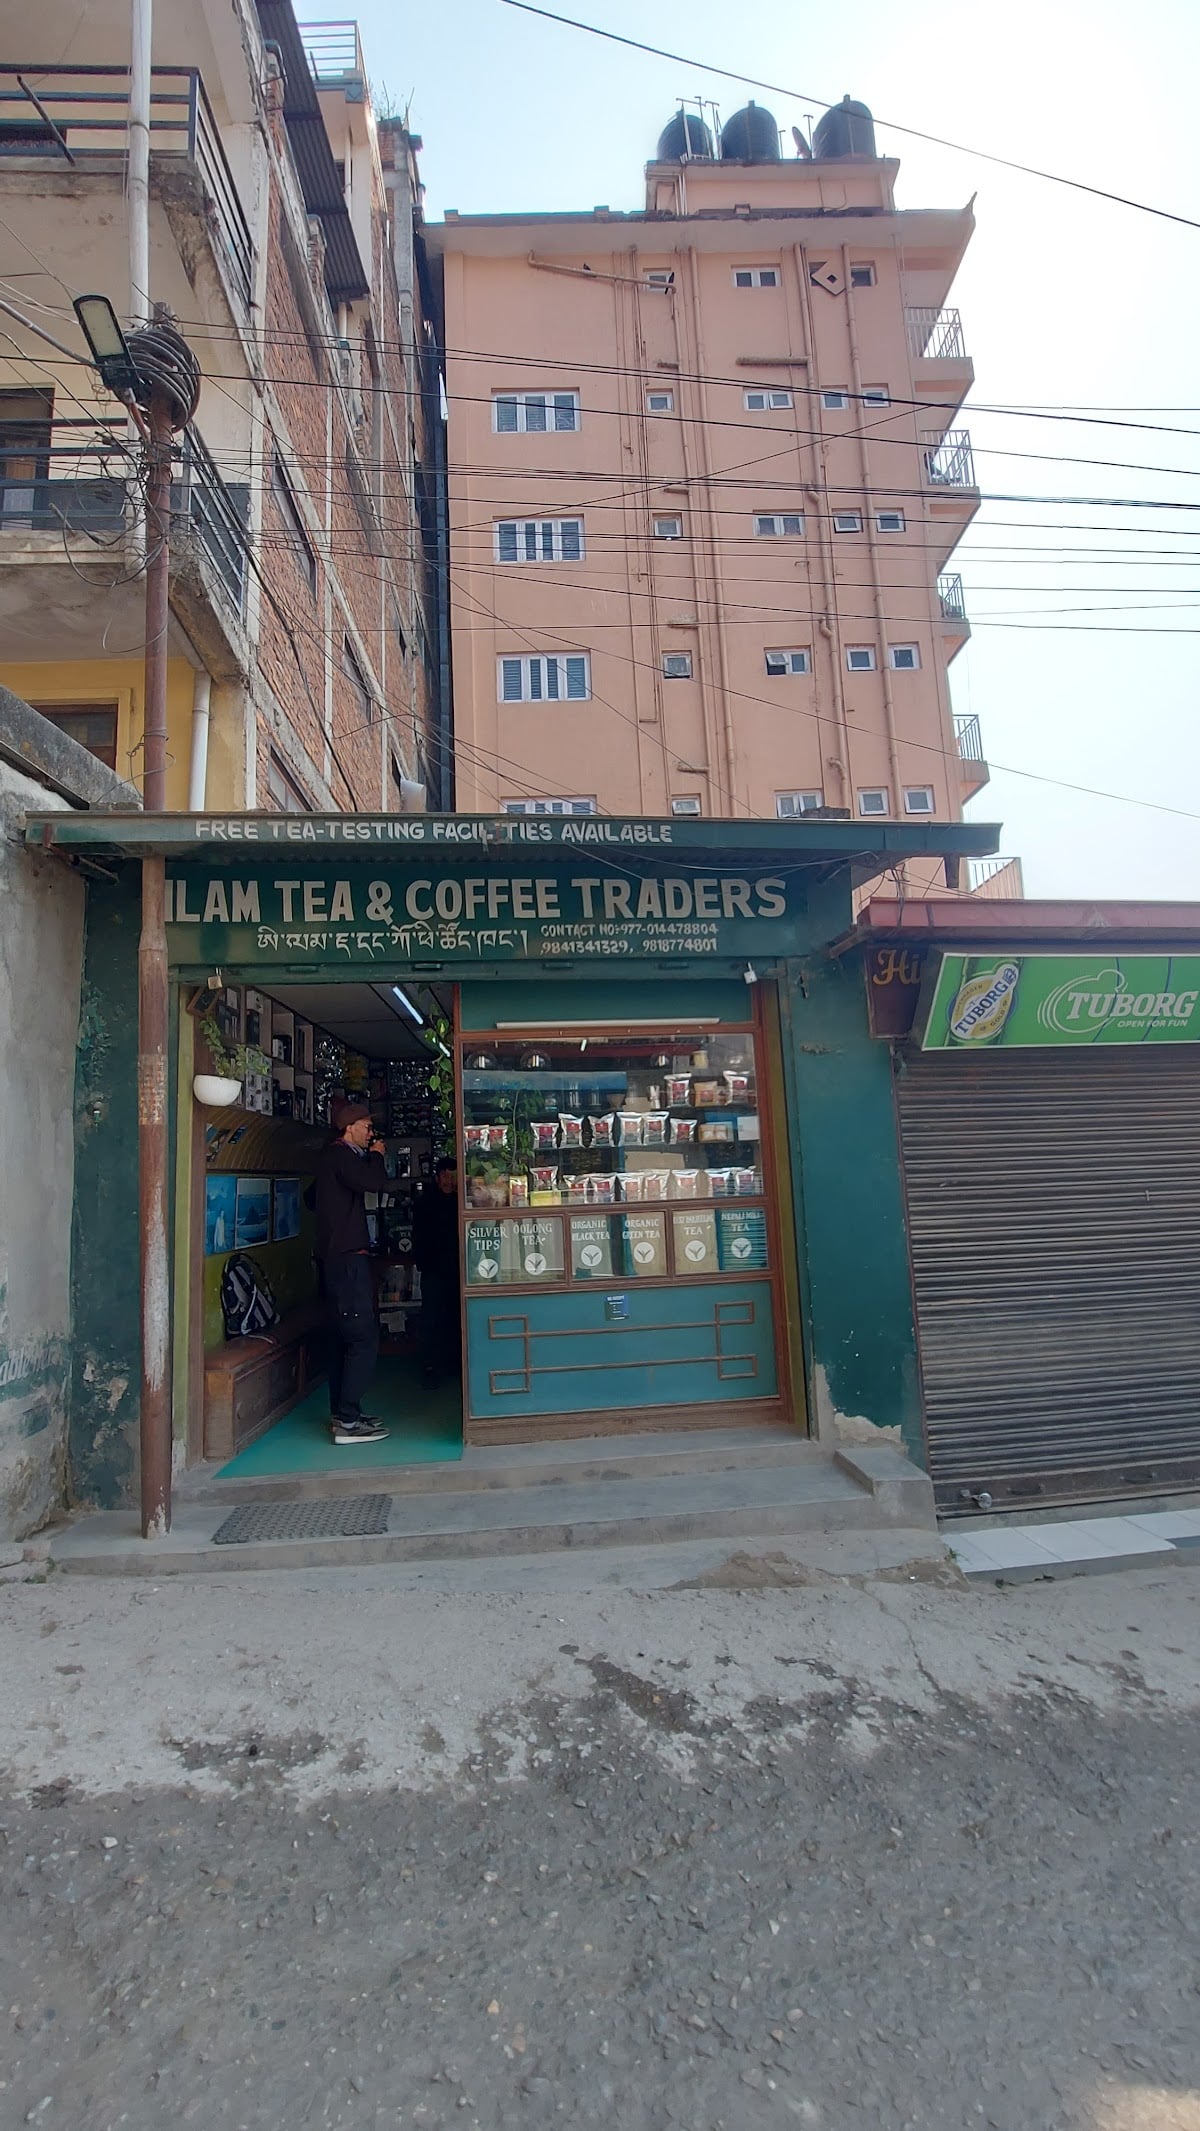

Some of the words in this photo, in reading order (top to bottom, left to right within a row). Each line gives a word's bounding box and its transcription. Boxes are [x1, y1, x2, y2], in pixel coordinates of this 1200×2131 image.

[196, 821, 259, 841] FREE
[267, 821, 425, 841] TEA-TESTING
[561, 822, 673, 844] AVAILABLE
[165, 880, 261, 923] ILAM
[274, 880, 355, 922] TEA
[366, 881, 394, 926] &
[405, 879, 561, 921] COFFEE
[571, 878, 786, 919] TRADERS
[540, 924, 595, 939] CONTACT
[955, 981, 1009, 1033] TUBORG
[1066, 991, 1199, 1019] TUBORG
[1117, 1019, 1145, 1028] OPEN
[1167, 1019, 1189, 1027] FUN
[513, 1223, 553, 1235] OOLONG
[571, 1220, 607, 1229] ORGANIC
[624, 1219, 660, 1228] ORGANIC
[731, 1223, 750, 1232] TEA
[469, 1227, 508, 1239] SILVER
[596, 1231, 611, 1240] TEA
[644, 1230, 661, 1239] TEA
[683, 1226, 703, 1236] TEA
[474, 1240, 501, 1251] TIPS
[522, 1235, 544, 1246] TEA
